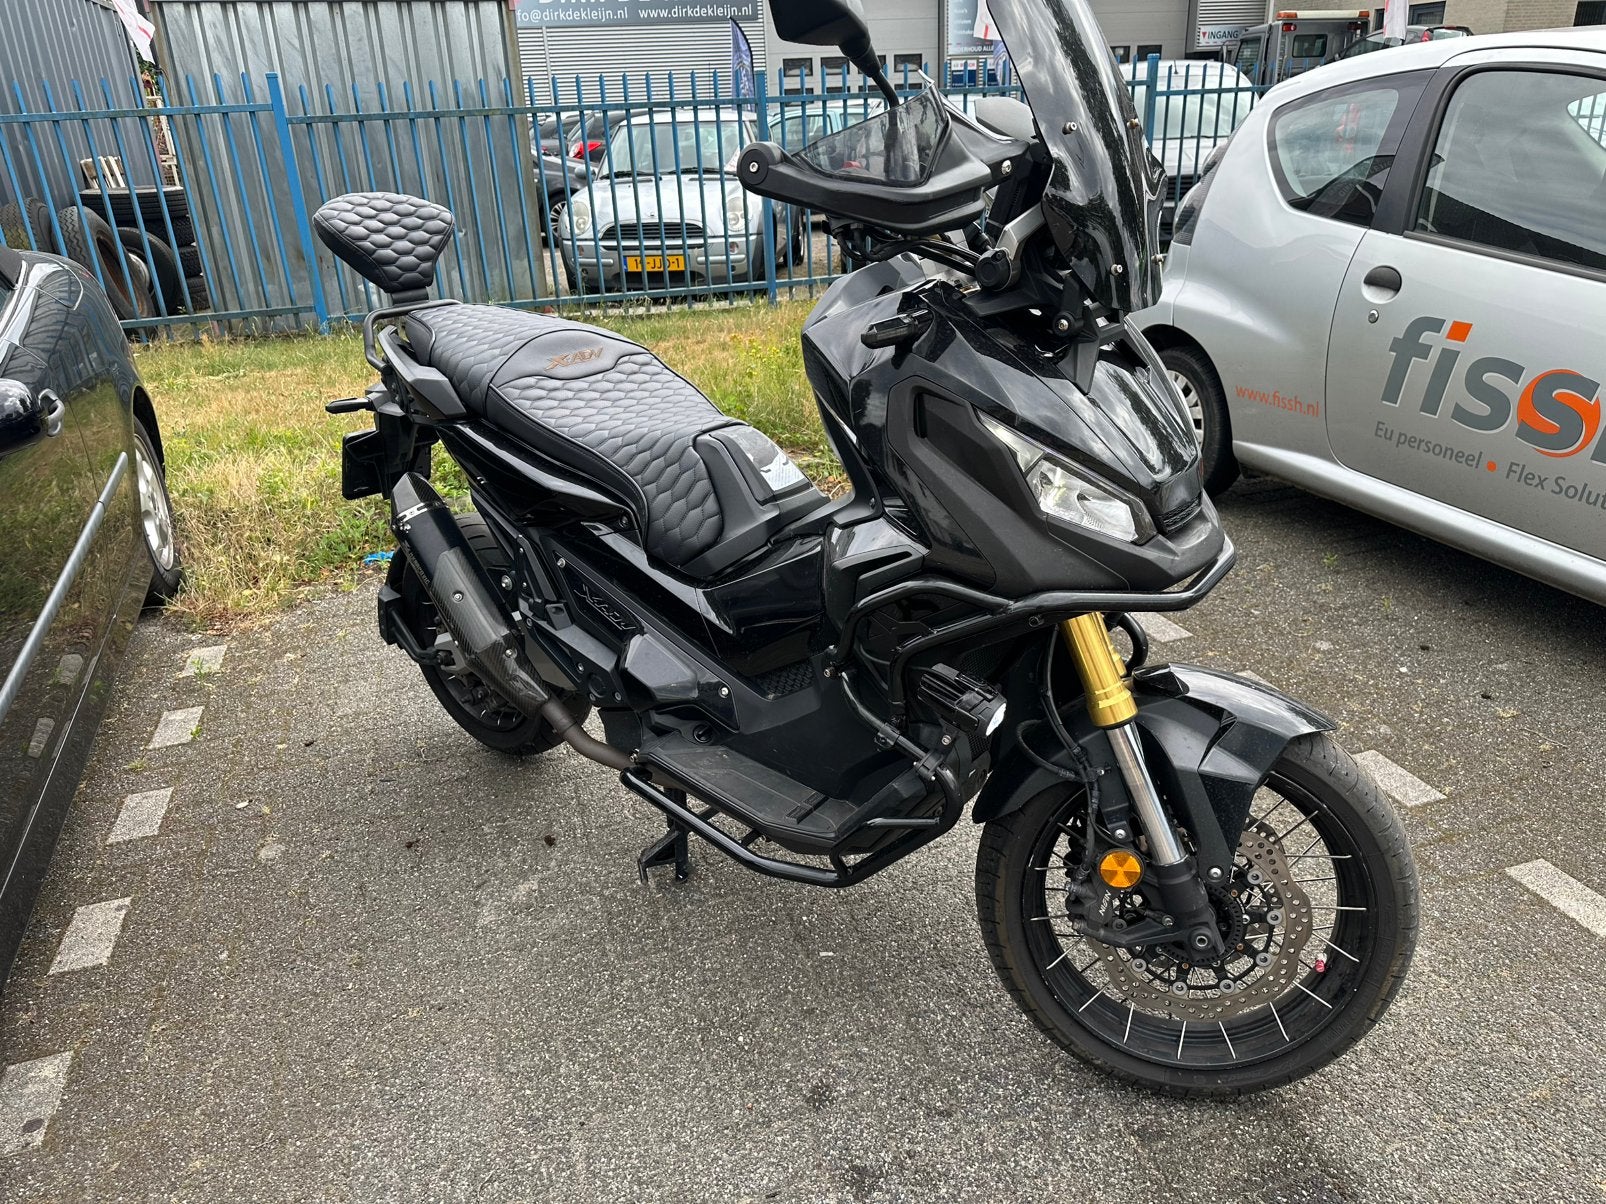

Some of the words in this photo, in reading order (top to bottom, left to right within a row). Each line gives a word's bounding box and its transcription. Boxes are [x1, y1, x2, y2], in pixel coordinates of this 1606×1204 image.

[639, 4, 752, 18] www.dirkdekleijn.nl
[1207, 30, 1239, 39] INGANG
[1234, 384, 1319, 418] www.fissh.nl
[1381, 316, 1606, 465] fiss
[1374, 421, 1394, 441] Eu
[1396, 431, 1483, 469] personeel
[1506, 461, 1549, 491] Flex
